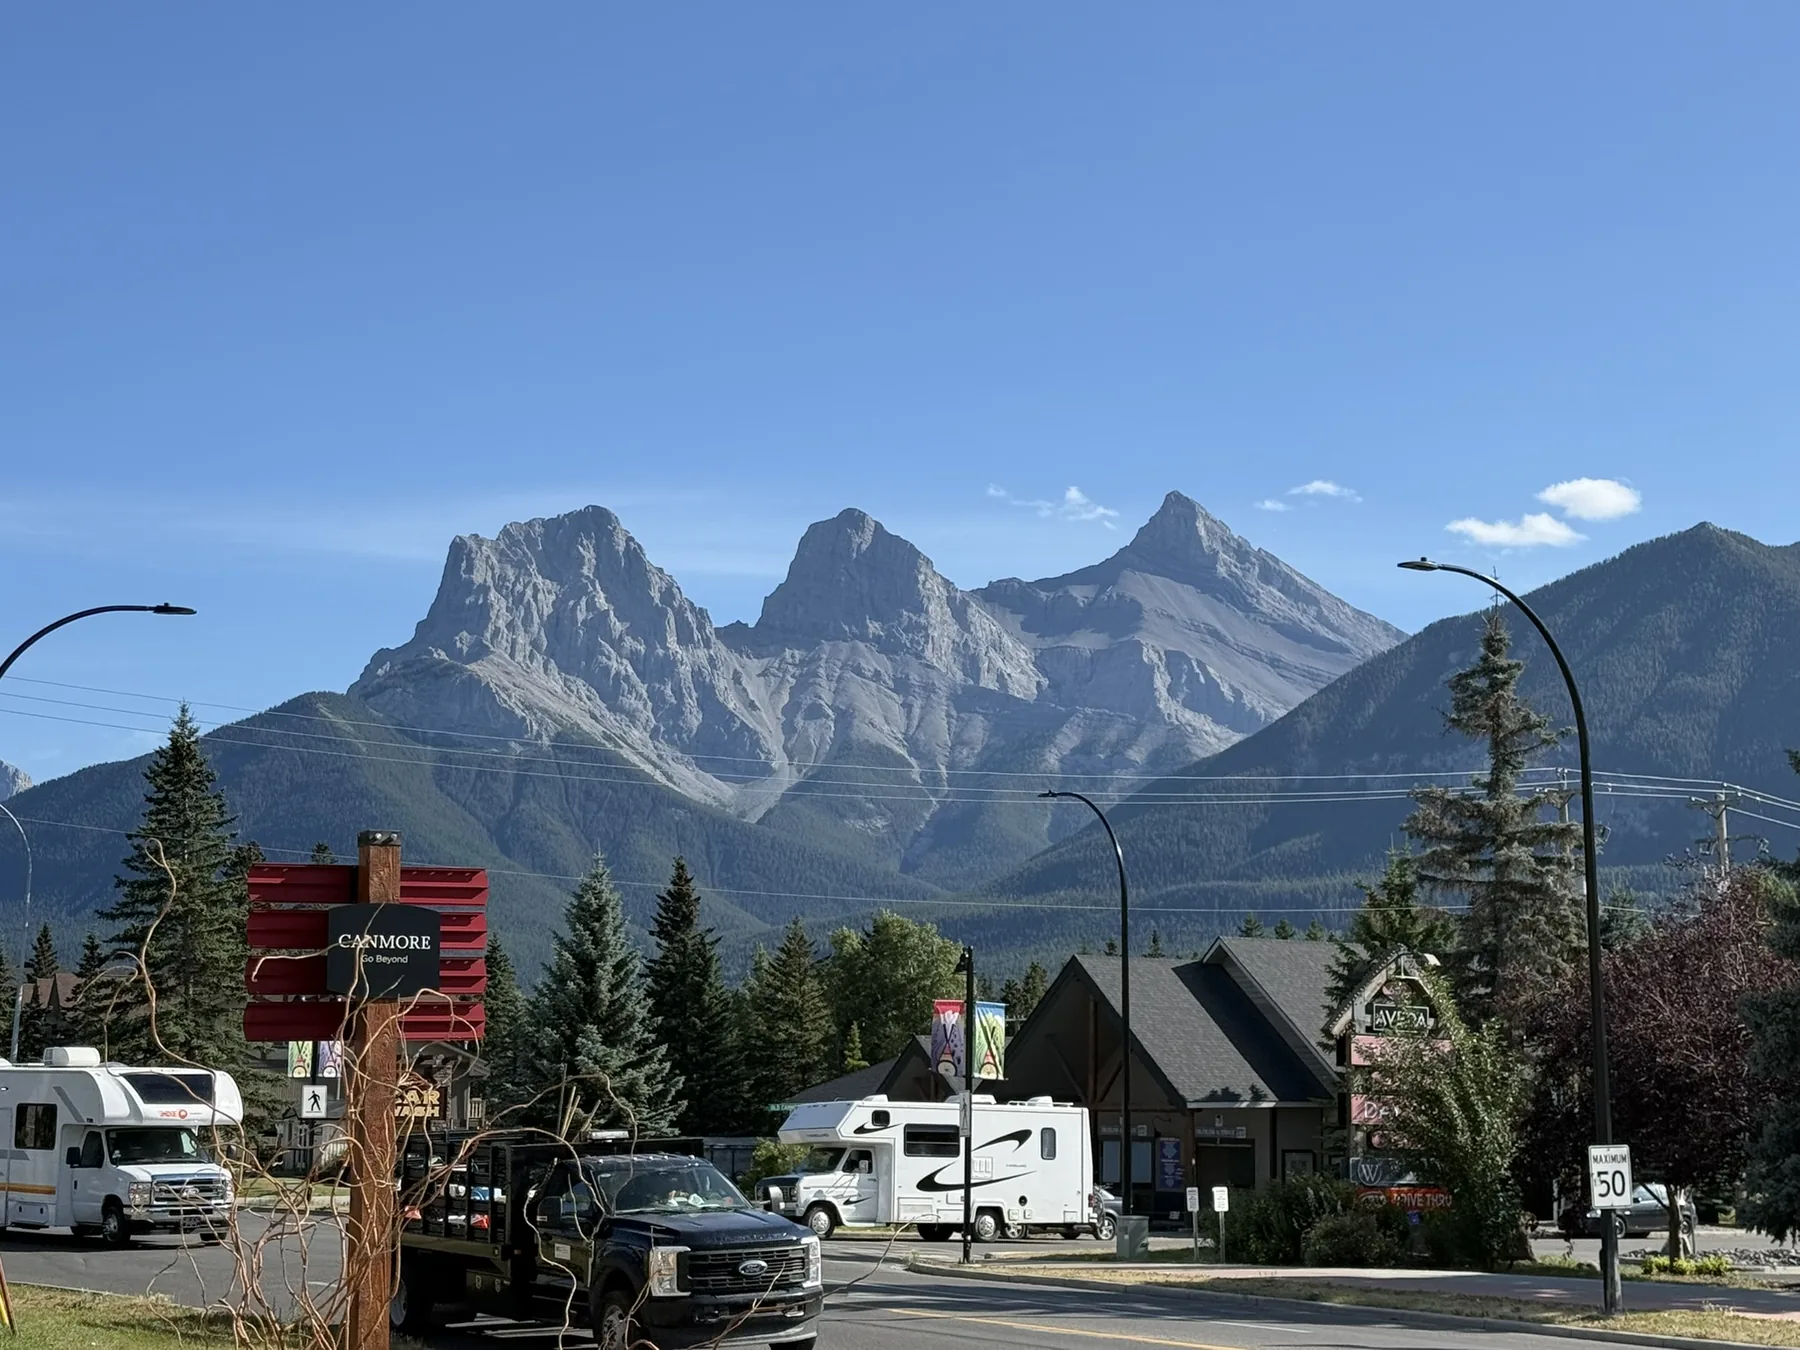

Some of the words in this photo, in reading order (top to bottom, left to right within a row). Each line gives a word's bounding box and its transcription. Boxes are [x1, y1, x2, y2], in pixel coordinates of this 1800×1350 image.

[338, 934, 431, 950] CANMORE
[361, 954, 374, 963] Go
[376, 955, 408, 965] Beyond
[1592, 1154, 1627, 1164] MAXIMUM
[1361, 1164, 1379, 1182] W
[1597, 1170, 1625, 1197] 50
